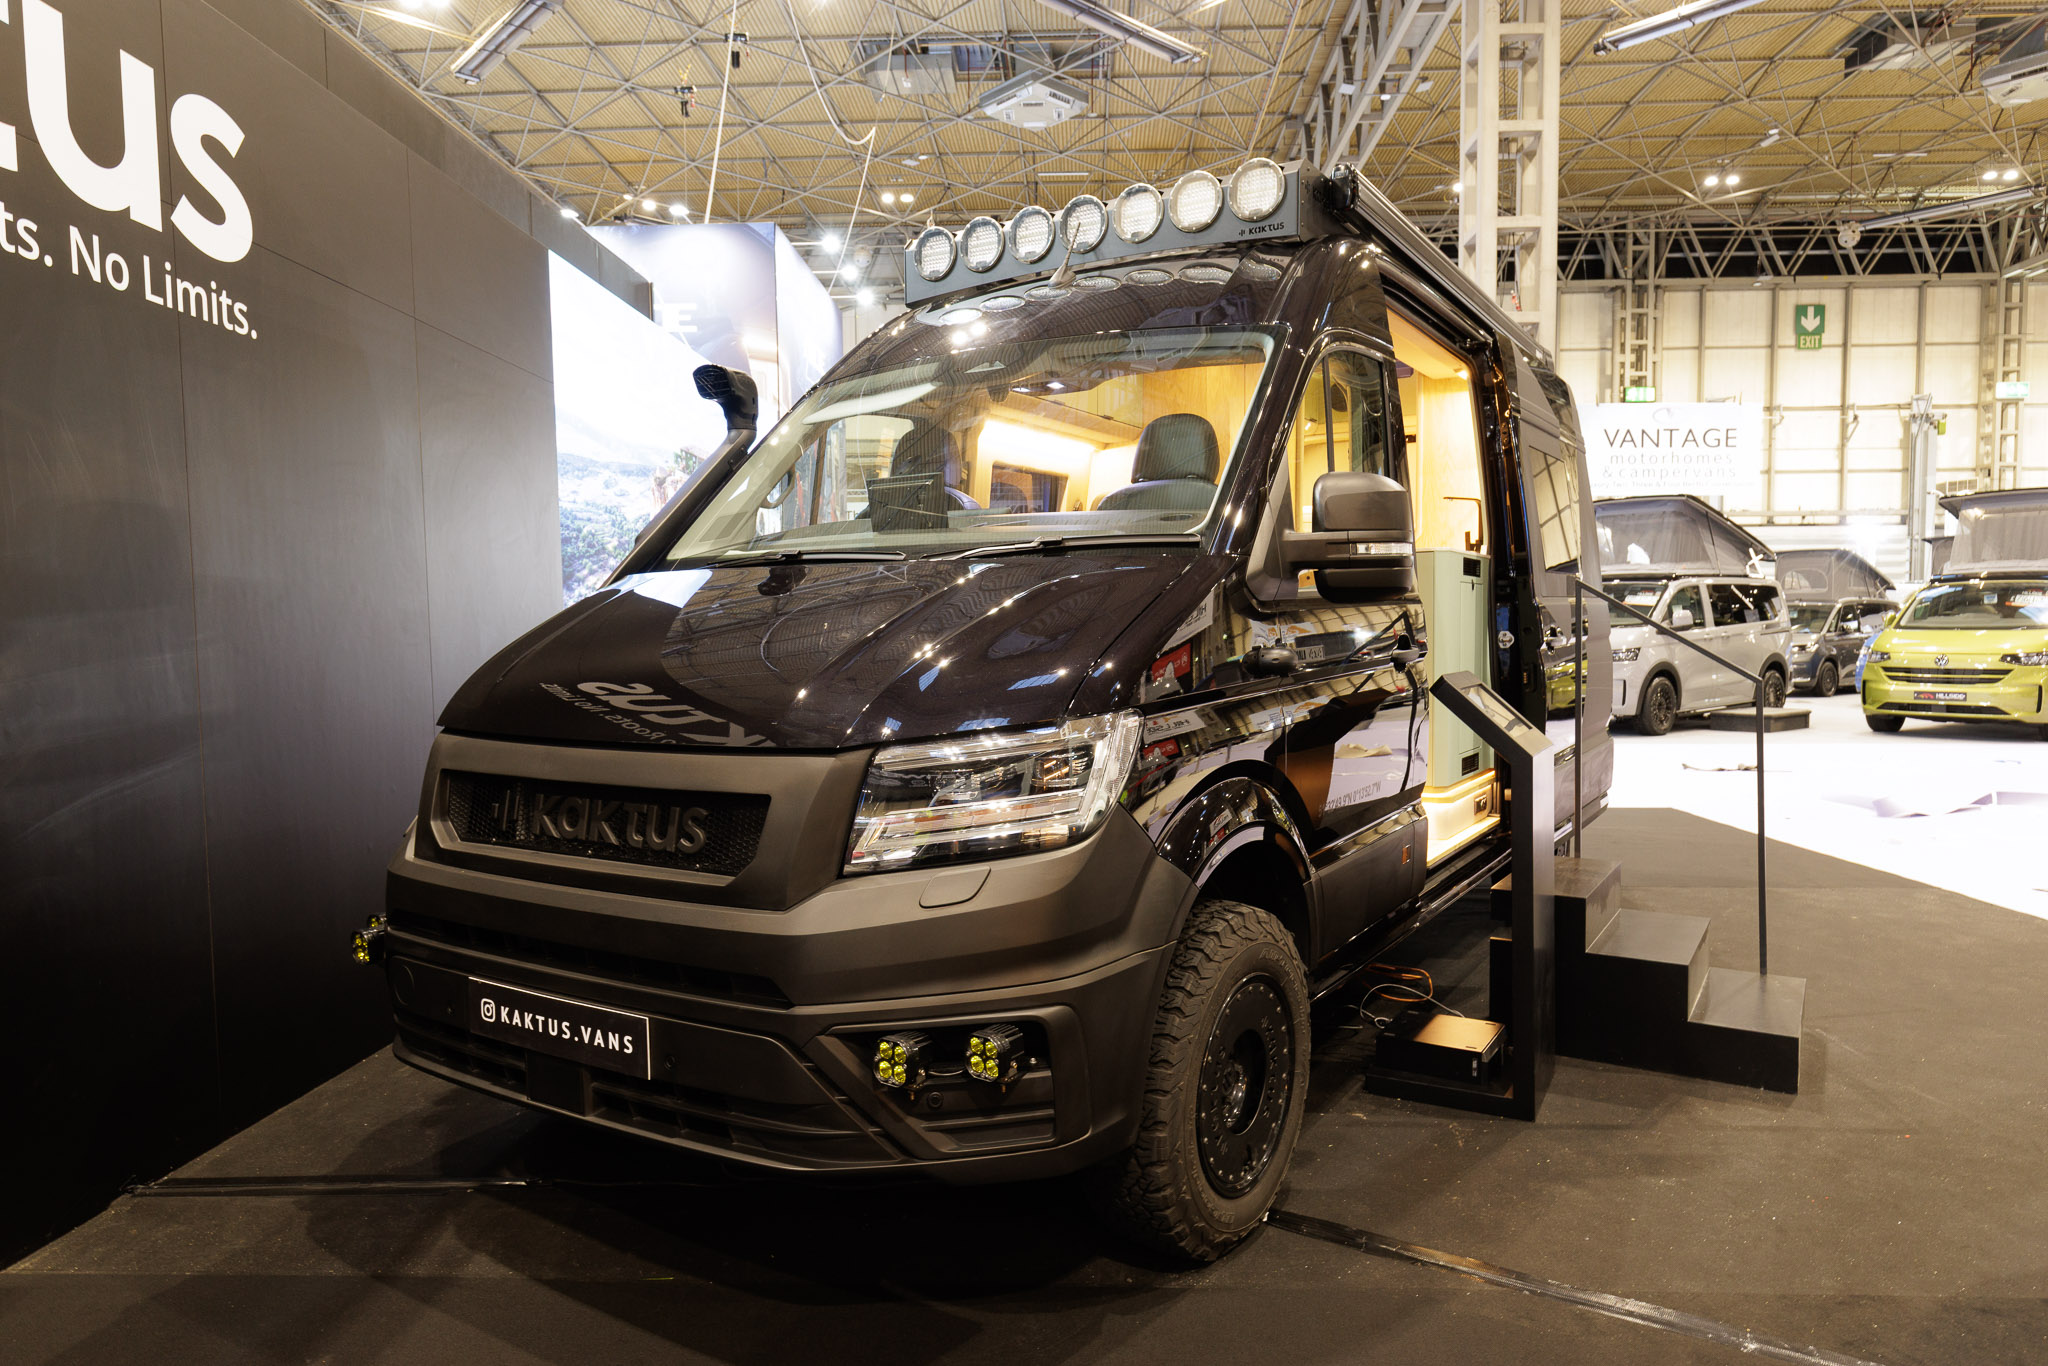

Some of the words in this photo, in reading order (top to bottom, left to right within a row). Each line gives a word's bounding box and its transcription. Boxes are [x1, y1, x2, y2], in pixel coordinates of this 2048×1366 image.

[69, 224, 130, 291] No
[143, 254, 258, 339] Limits.
[1799, 335, 1820, 348] EXIT
[1603, 428, 1737, 449] VANTAGE
[1610, 451, 1733, 465] motorhomes
[1602, 465, 1613, 479] &
[1618, 467, 1736, 481] campervans
[500, 1005, 633, 1054] KAKTUS.VANS
